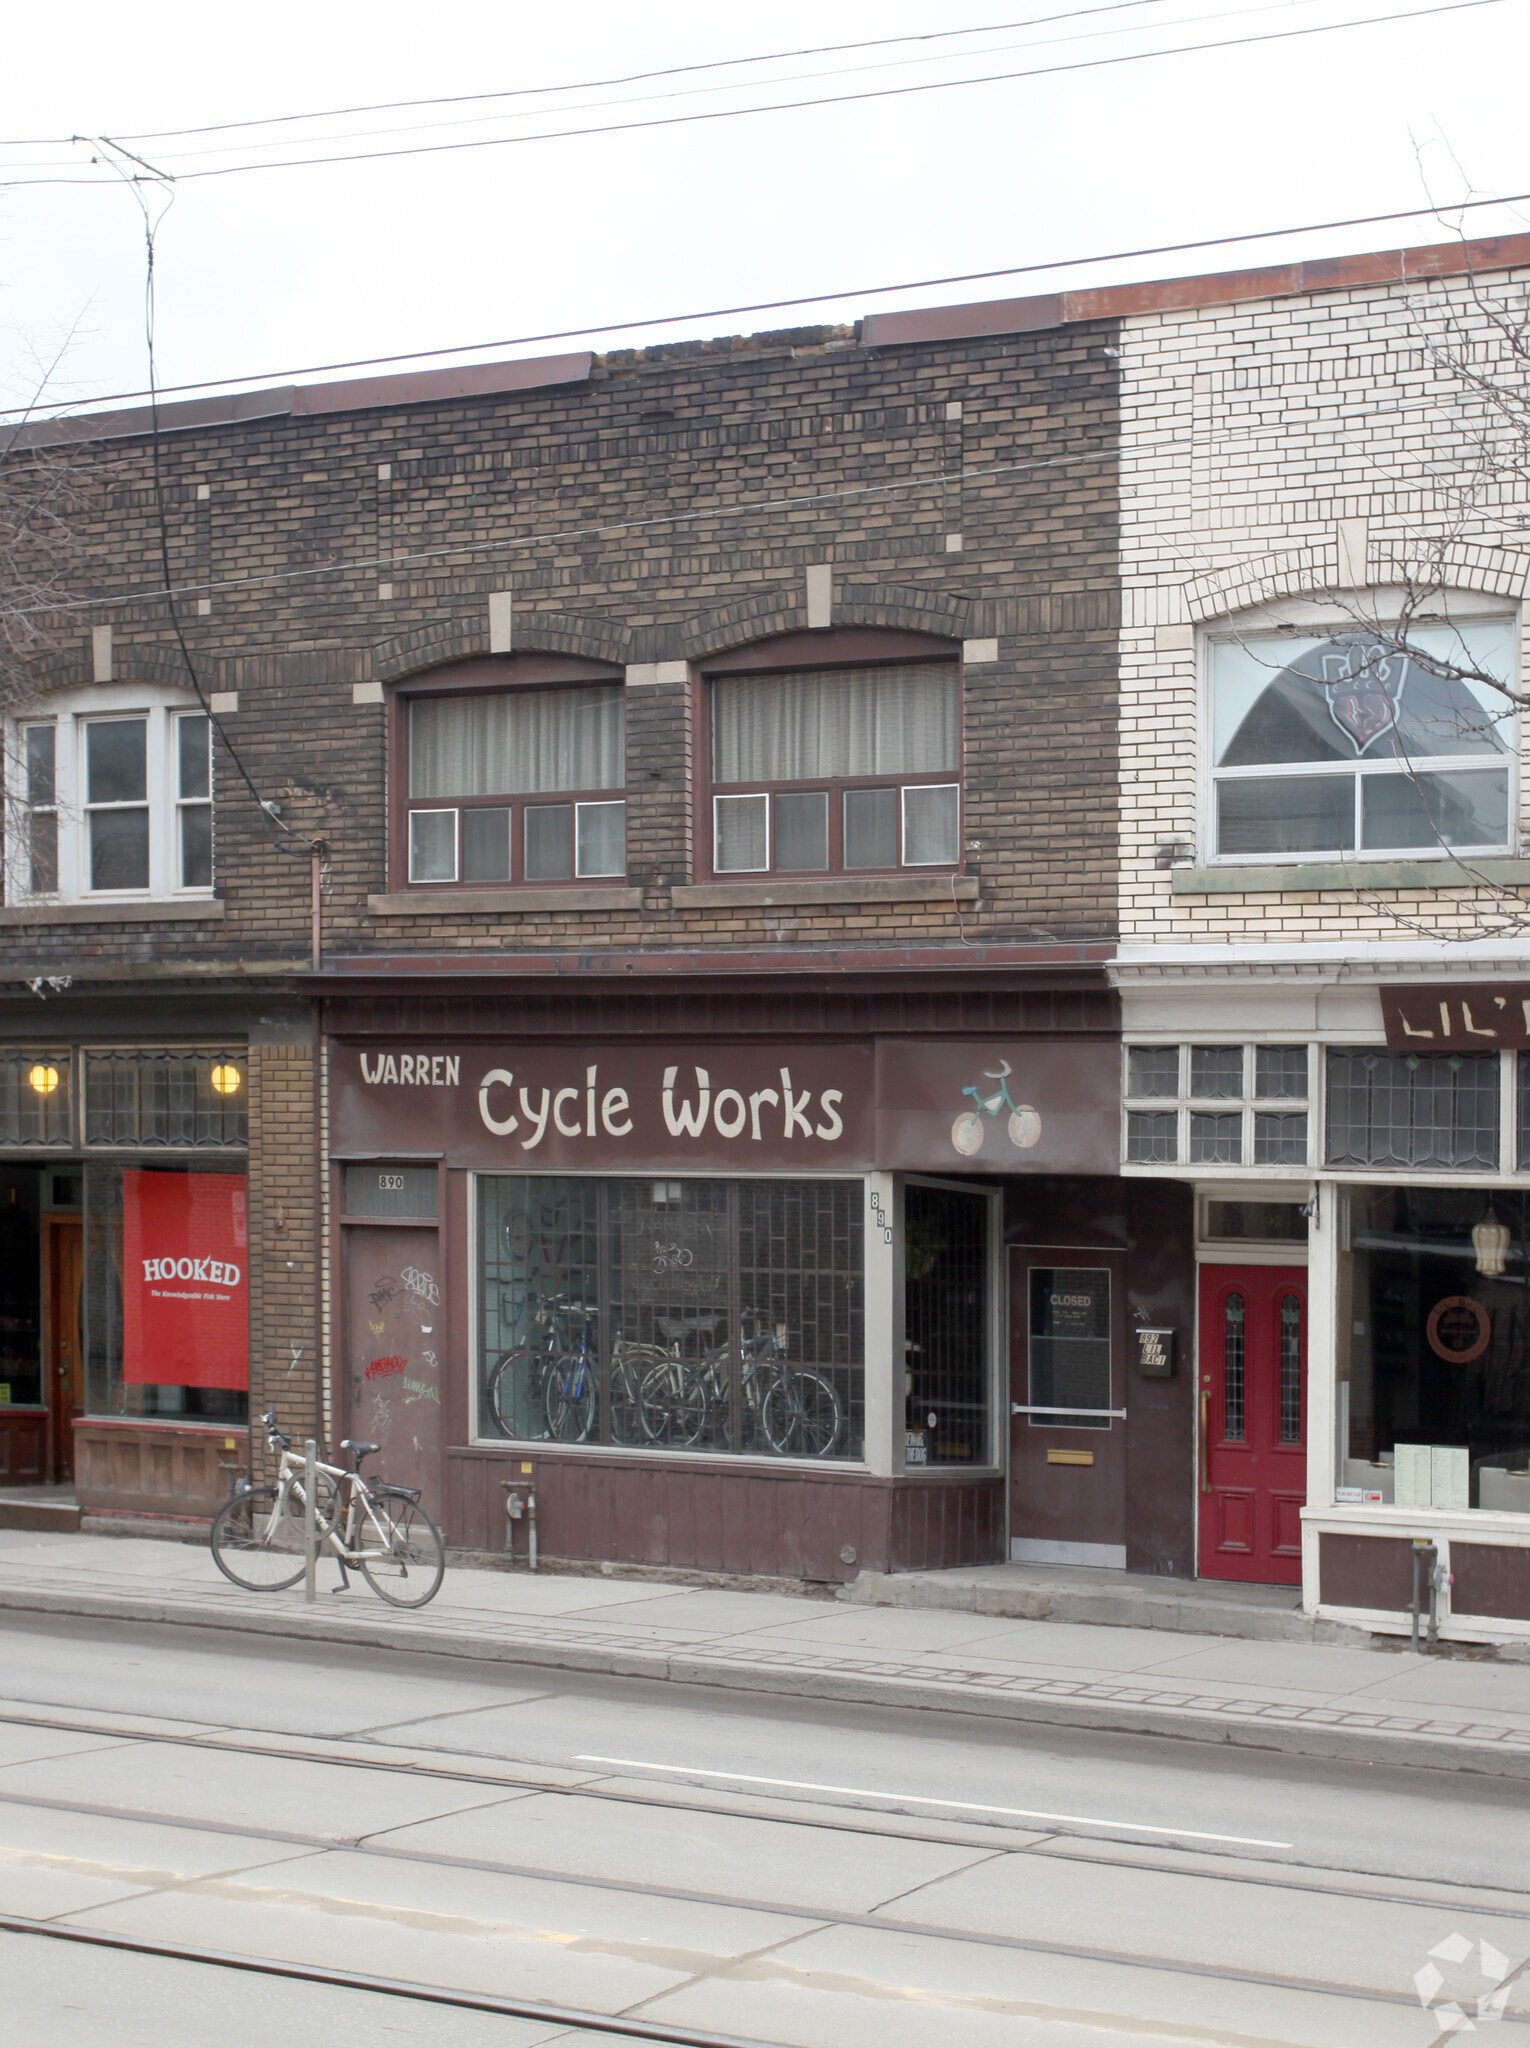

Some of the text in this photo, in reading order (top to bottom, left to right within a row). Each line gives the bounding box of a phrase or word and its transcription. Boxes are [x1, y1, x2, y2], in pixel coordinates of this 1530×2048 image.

[360, 1053, 460, 1086] WARREN
[479, 1064, 843, 1150] Cycle Works
[380, 1176, 402, 1188] 890
[871, 1194, 892, 1244] 890
[142, 1254, 241, 1287] HOOKED
[1050, 1294, 1091, 1307] CLOSED
[1140, 1334, 1158, 1343] 892
[1143, 1344, 1161, 1354] LIL
[1141, 1354, 1165, 1364] BACI
